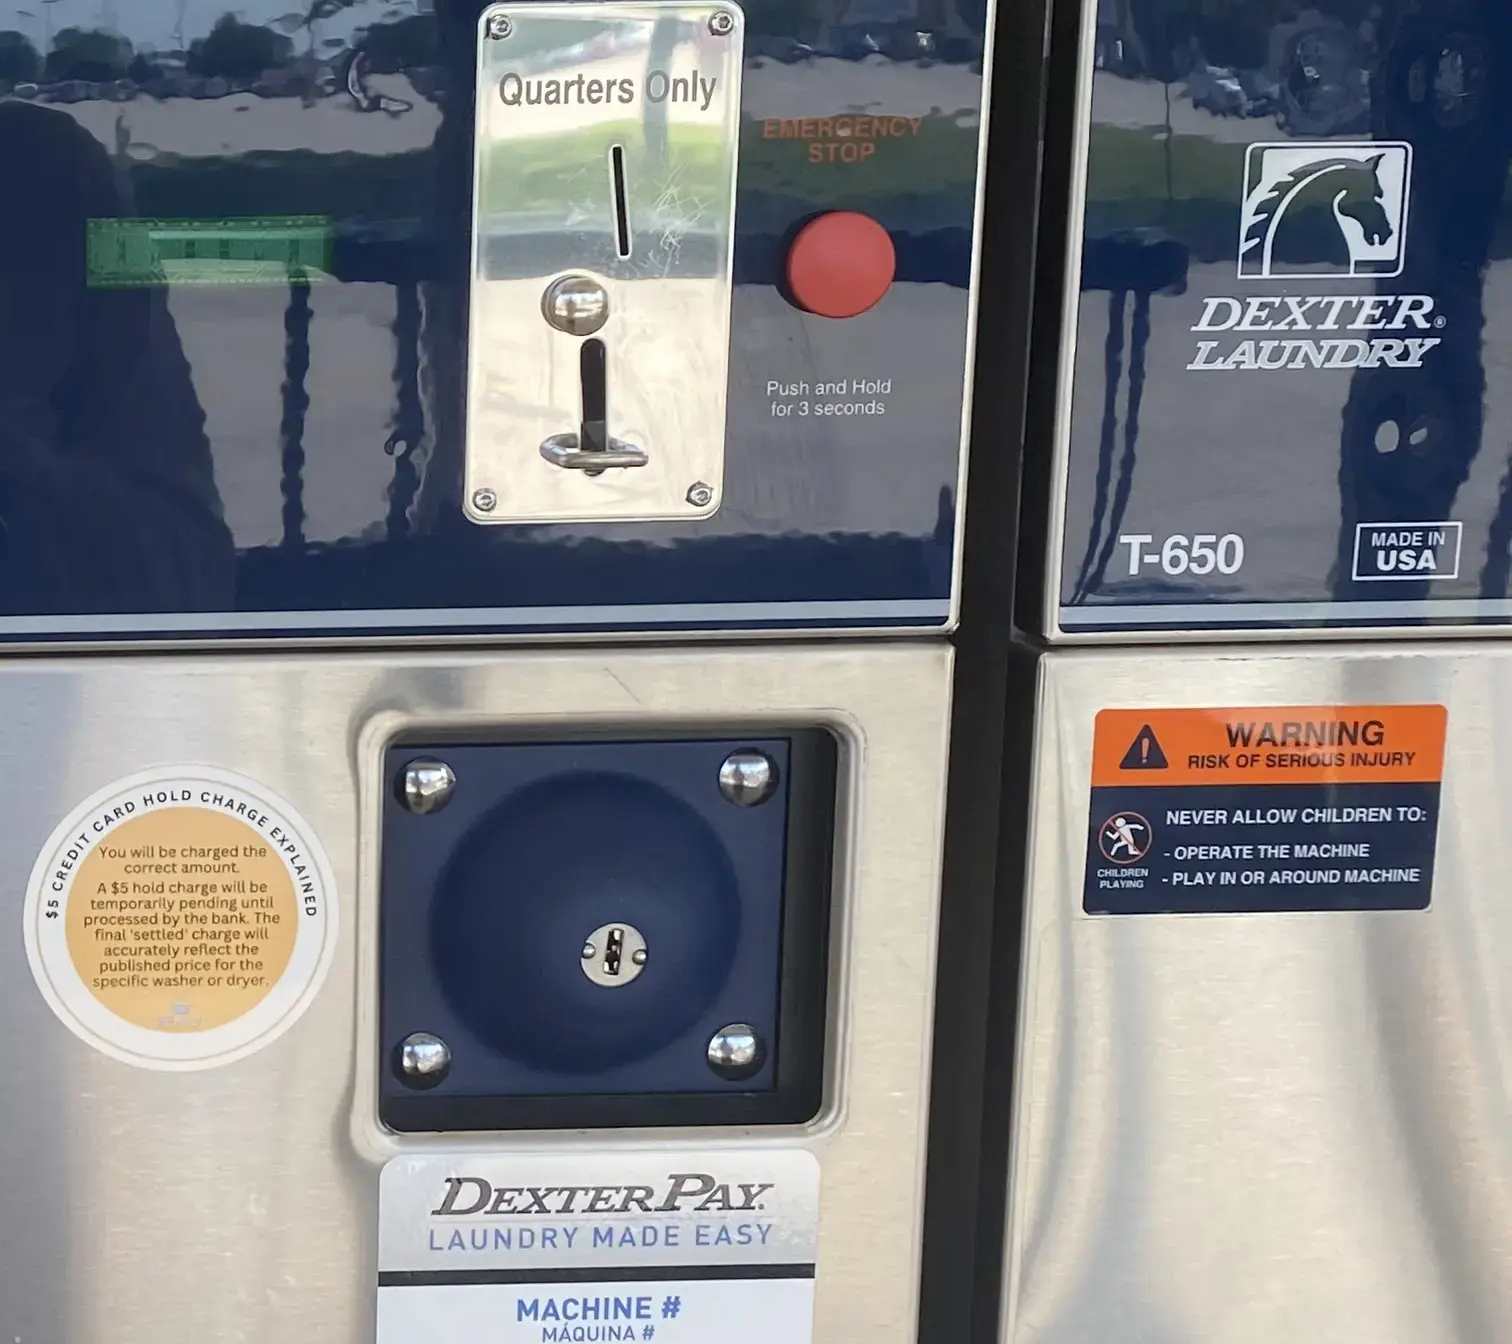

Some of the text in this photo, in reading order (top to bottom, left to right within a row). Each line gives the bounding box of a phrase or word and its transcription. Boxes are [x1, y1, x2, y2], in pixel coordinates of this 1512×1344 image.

[499, 70, 717, 111] Quarters Only
[763, 117, 923, 140] EMERGENCY
[808, 143, 875, 163] STOP
[1186, 338, 1441, 370] LAUNDRY
[767, 379, 891, 396] Push and Hold
[771, 399, 885, 416] for 3 seconds
[1371, 532, 1445, 548] MADE IN
[1120, 533, 1244, 575] T-650
[1376, 548, 1437, 571] USA
[1226, 721, 1384, 748] WARNING
[1188, 752, 1416, 769] RISK OF SERIOUS INJURY
[1166, 808, 1426, 825] NEVER ALLOW CHILDREN TO:
[46, 790, 317, 919] $5 CREDIT CARD HOLD CHARGE EXPLAINED
[99, 846, 267, 860] You will be charged the
[1174, 844, 1369, 859] OPERATE THE MACHINE
[124, 862, 240, 874] correct amount.
[1098, 868, 1148, 878] CHILDREN
[1100, 879, 1144, 889] PLAYING
[1172, 869, 1421, 885] PLAY IN OR AROUND MACHINE
[97, 881, 267, 896] A $5 hold charge will be
[91, 896, 274, 912] temporarily pending until
[84, 912, 280, 928] processed by the bank. The
[95, 929, 126, 941] final
[192, 928, 240, 942] charge
[245, 927, 268, 939] will
[104, 944, 259, 958] accurately reflect the
[100, 959, 263, 974] published price for the
[429, 1224, 773, 1251] LAUNDRY MADE EASY
[517, 1296, 680, 1322] MACHINE #
[542, 1324, 655, 1344] MÁQUINA #
